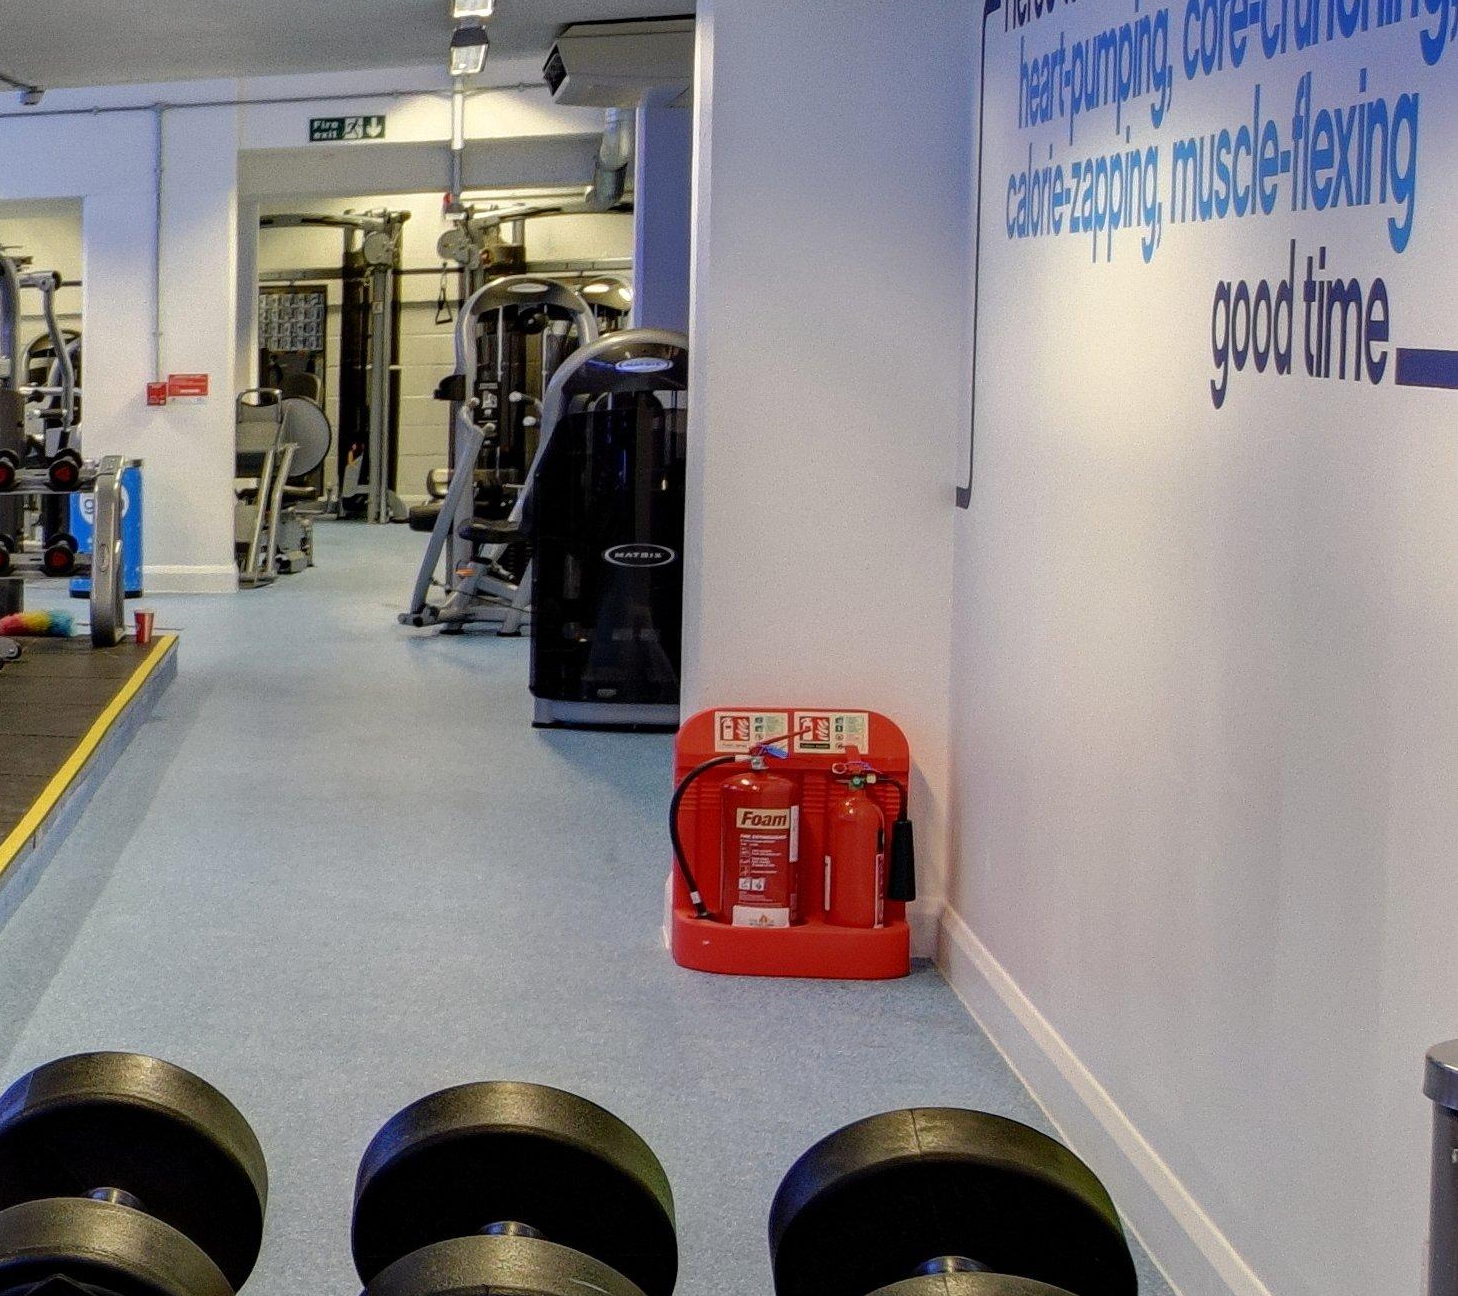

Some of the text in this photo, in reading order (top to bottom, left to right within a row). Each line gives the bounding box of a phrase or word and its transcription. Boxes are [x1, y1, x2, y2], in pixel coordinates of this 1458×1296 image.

[312, 119, 340, 130] Fire
[1006, 69, 1420, 264] calorie-zapping, muscle-flexing
[1209, 239, 1391, 410] good time
[613, 551, 663, 559] MATRIX
[740, 810, 788, 827] Foam
